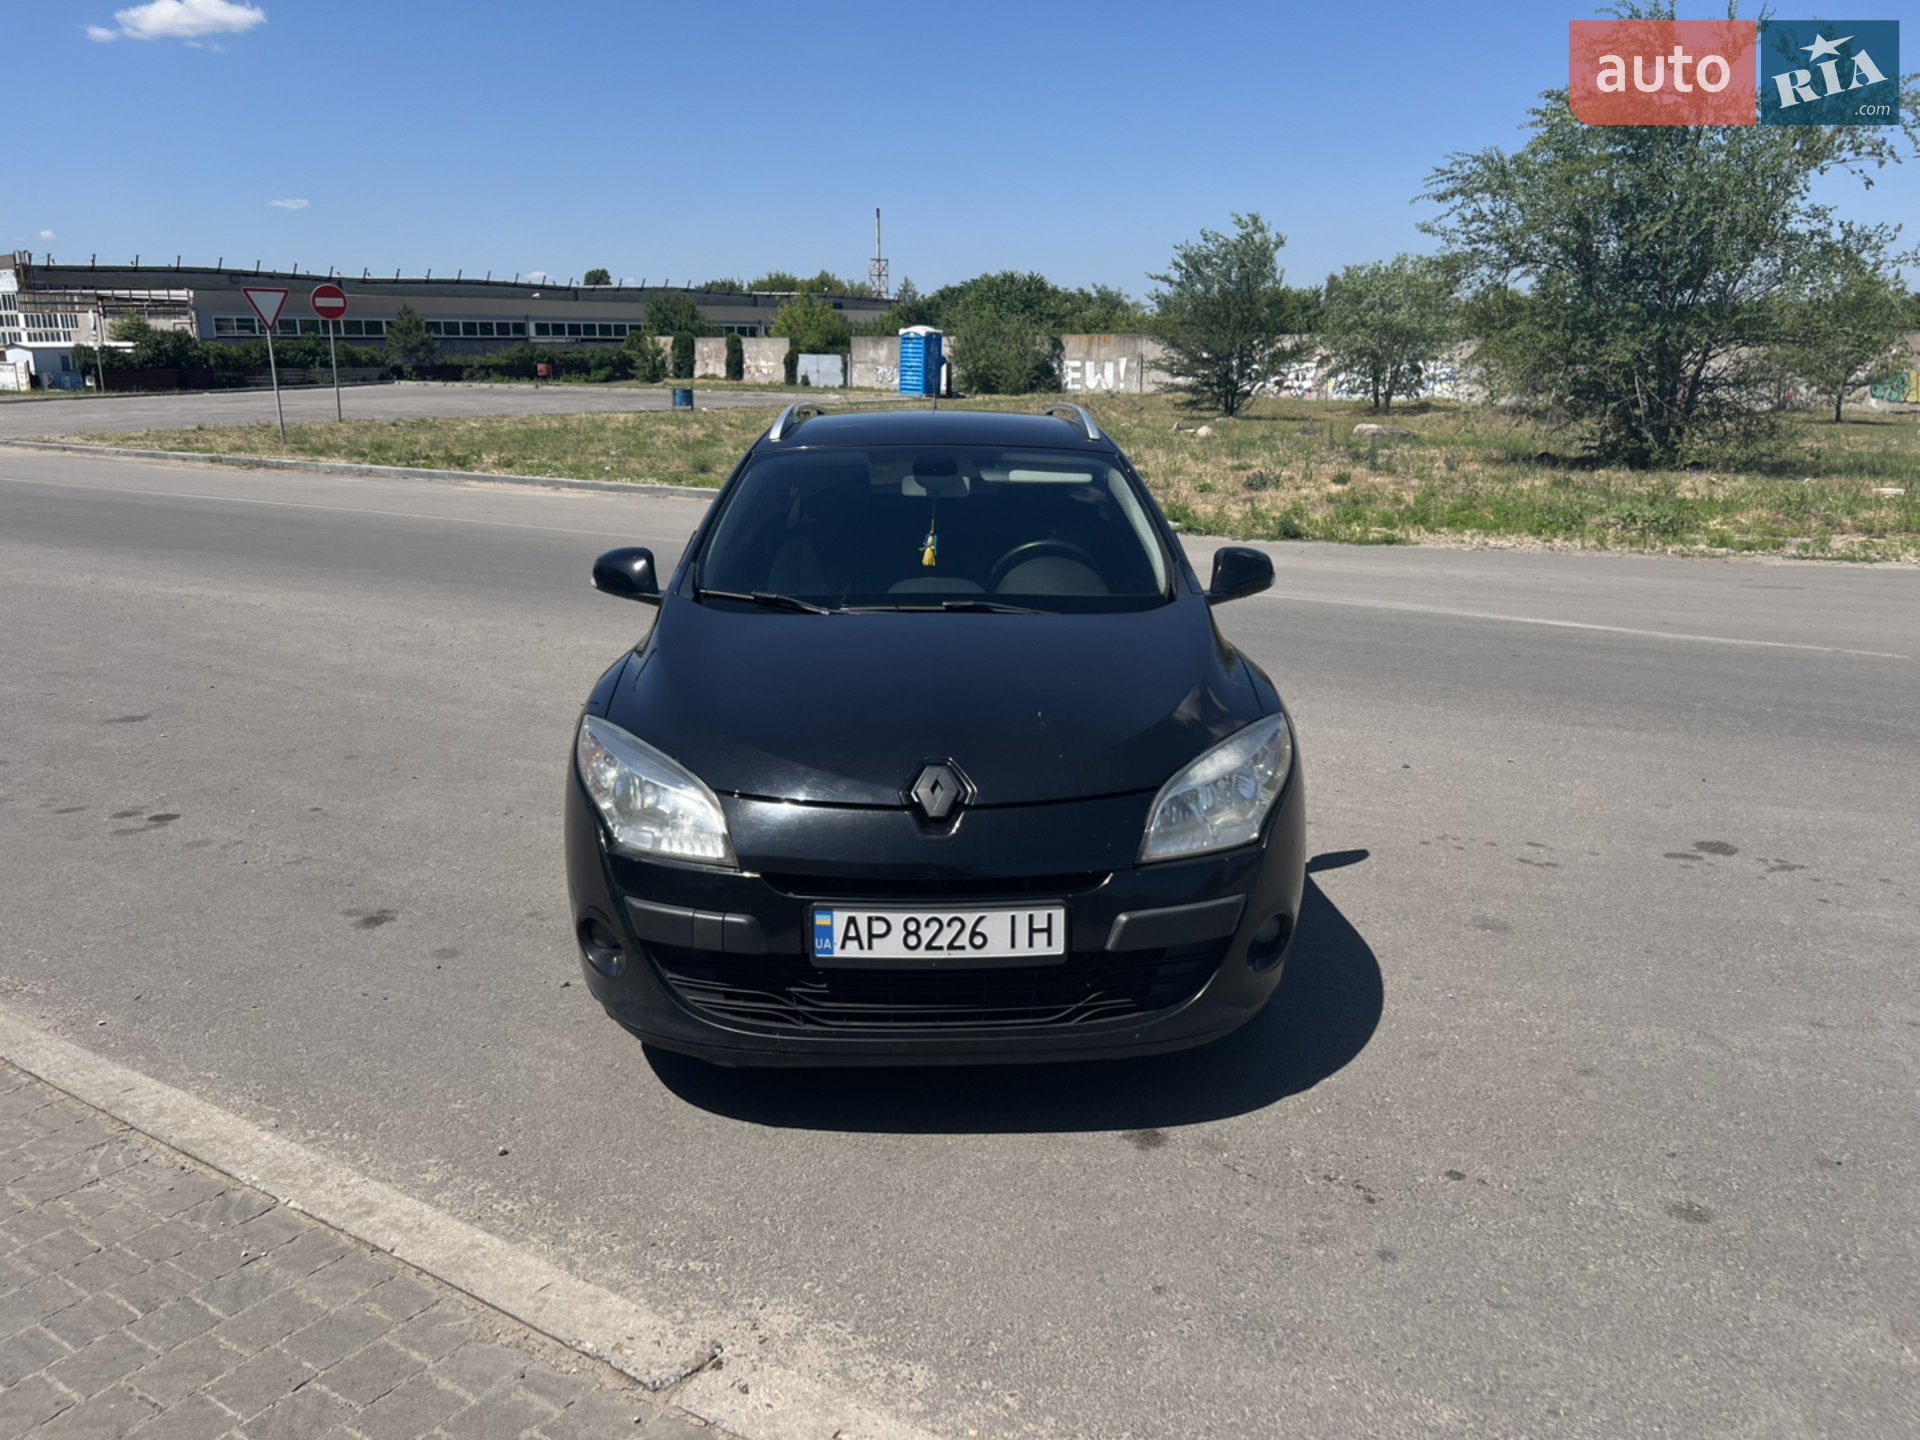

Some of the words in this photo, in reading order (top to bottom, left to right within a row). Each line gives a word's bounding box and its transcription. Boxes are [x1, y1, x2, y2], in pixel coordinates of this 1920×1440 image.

[815, 938, 832, 949] UA
[839, 915, 893, 951] AP
[902, 915, 989, 951] 8226
[1010, 912, 1054, 949] IH
